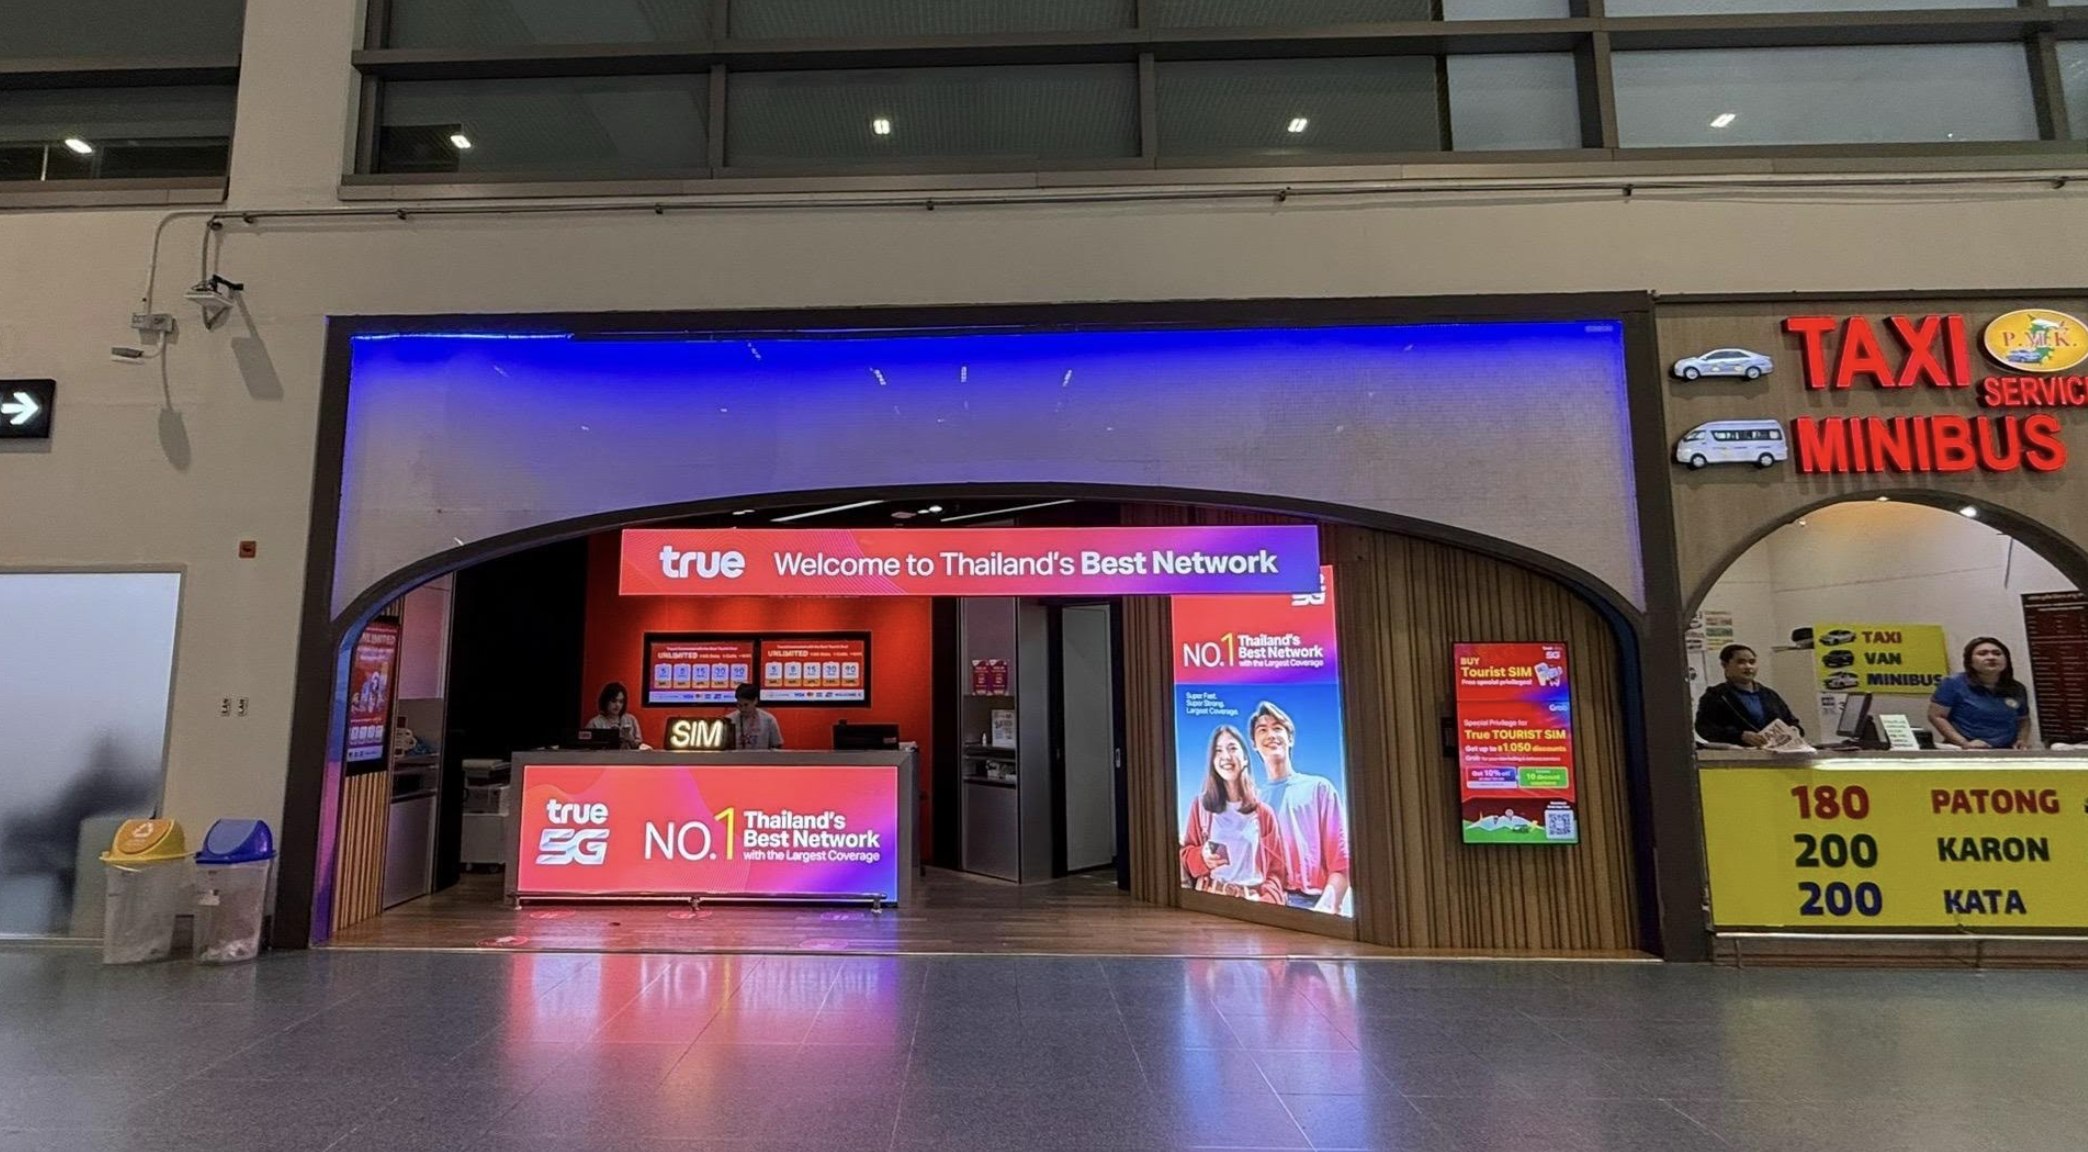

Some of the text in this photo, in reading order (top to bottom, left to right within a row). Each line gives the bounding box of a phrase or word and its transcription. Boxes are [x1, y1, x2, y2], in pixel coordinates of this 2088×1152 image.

[1785, 314, 1972, 390] TAXI
[1983, 376, 2088, 407] SERVIC
[1796, 413, 2067, 473] MINIBUS
[659, 545, 746, 579] true
[773, 549, 1279, 577] Welcome to Thailand's Best Network
[1237, 633, 1301, 647] Thailand's
[1860, 630, 1902, 644] TAXI
[1238, 645, 1324, 659] Best Network
[1460, 657, 1480, 666] BUY
[1864, 652, 1901, 665] VAN
[1264, 660, 1290, 669] Largest
[1290, 659, 1324, 669] Coverage
[1460, 665, 1533, 678] Tourist SIM
[1867, 673, 1943, 687] MINIBUS
[1463, 719, 1489, 727] Special
[670, 719, 724, 748] SIM
[1464, 729, 1566, 740] True TOURIST SIM
[545, 798, 609, 825] true
[1791, 785, 1870, 820] 180
[1931, 788, 2061, 814] PATONG
[743, 809, 847, 830] Thailand's
[535, 828, 610, 865] 5G
[743, 829, 880, 848] Best Network
[743, 849, 881, 864] with the Largest Coverage
[1793, 833, 2050, 868] 200 KARON
[1798, 881, 2027, 917] 200 KATA
